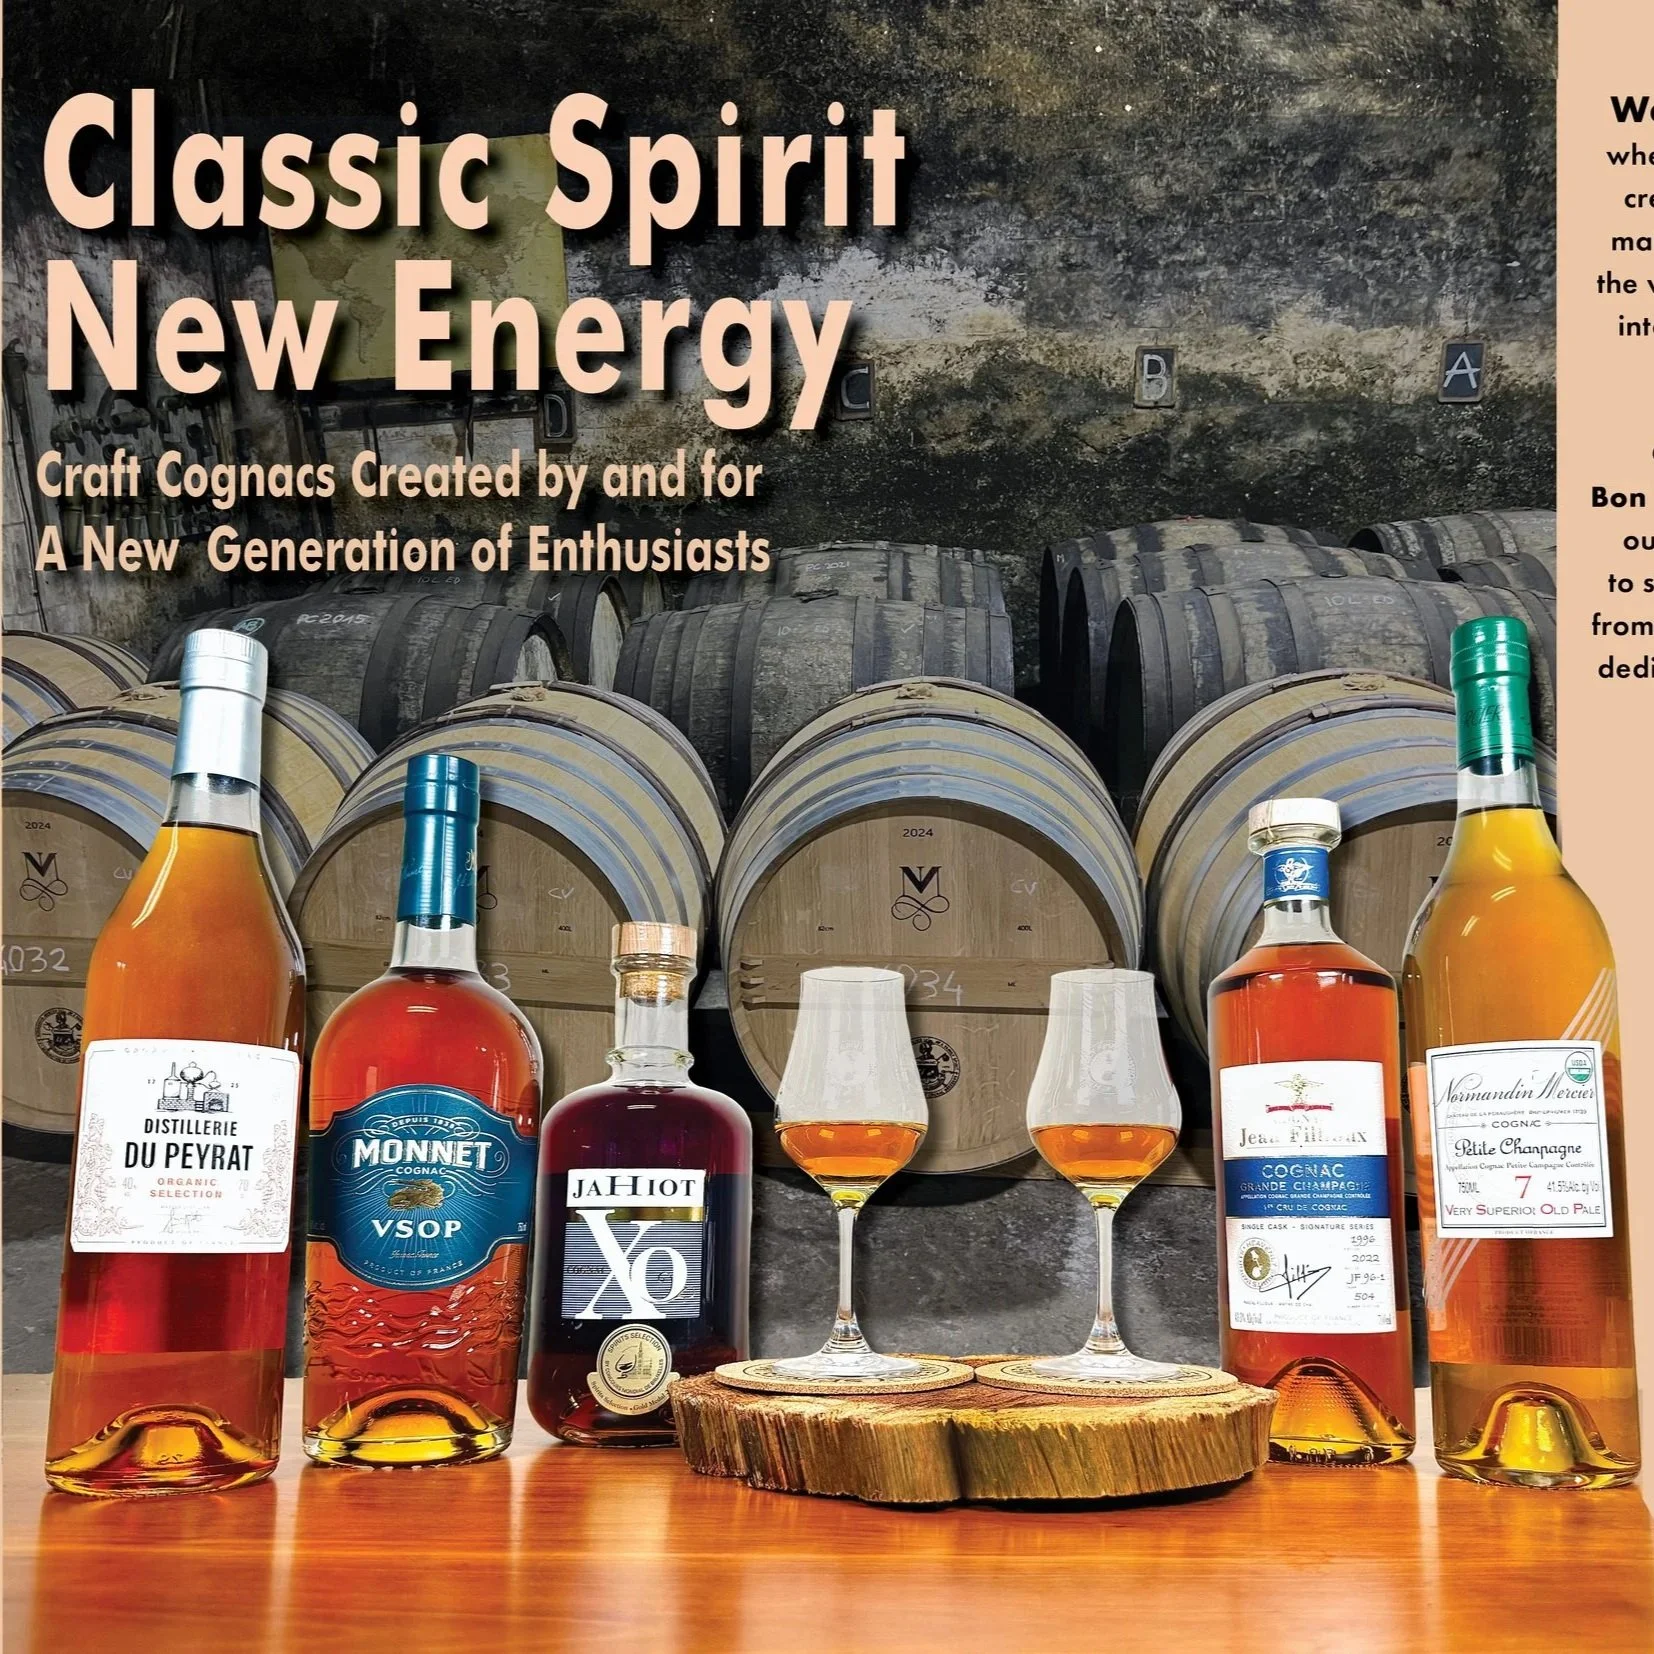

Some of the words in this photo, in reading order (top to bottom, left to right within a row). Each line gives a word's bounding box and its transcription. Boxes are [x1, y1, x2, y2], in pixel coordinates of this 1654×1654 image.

[1143, 352, 1169, 401] B
[1442, 350, 1482, 389] A
[841, 366, 870, 409] C
[544, 393, 568, 438] D
[25, 821, 51, 830] 2024
[902, 828, 934, 838] 2024
[1432, 1072, 1534, 1108] Normandin
[1532, 1070, 1595, 1100] Mercier
[144, 1118, 238, 1137] DISTILLERIE
[391, 1116, 429, 1128] DEPUIS
[1491, 1120, 1542, 1129] COGNAC
[124, 1141, 156, 1169] DU
[164, 1142, 254, 1171] PEYRAT
[352, 1138, 493, 1171] MONNET
[1454, 1138, 1497, 1158] Petite
[395, 1166, 447, 1176] COGNAC
[1261, 1163, 1345, 1179] COGNAC
[157, 1177, 218, 1187] ORGANIC
[1240, 1181, 1287, 1192] GRANDE
[1514, 1175, 1532, 1199] 7
[149, 1189, 223, 1199] SELECTION
[371, 1219, 463, 1239] VSOP
[1351, 1254, 1380, 1262] 2022
[607, 1333, 630, 1354] SPIRITS
